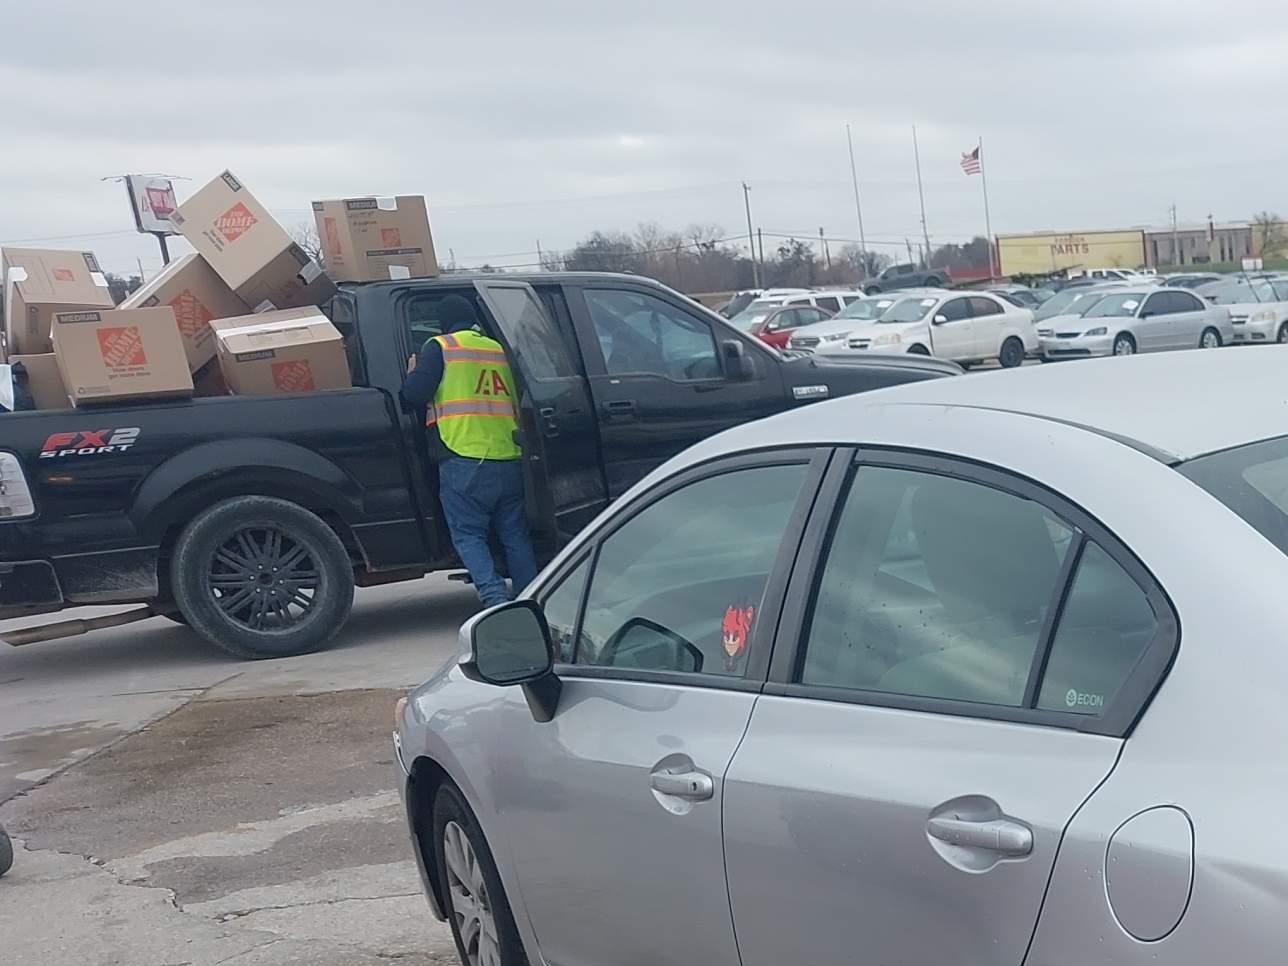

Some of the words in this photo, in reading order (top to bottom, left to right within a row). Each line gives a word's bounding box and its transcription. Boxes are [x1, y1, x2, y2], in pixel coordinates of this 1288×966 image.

[59, 313, 99, 322] MEDIUM
[41, 427, 140, 451] FX2
[40, 444, 134, 459] SPORT
[1077, 693, 1104, 706] ECON
